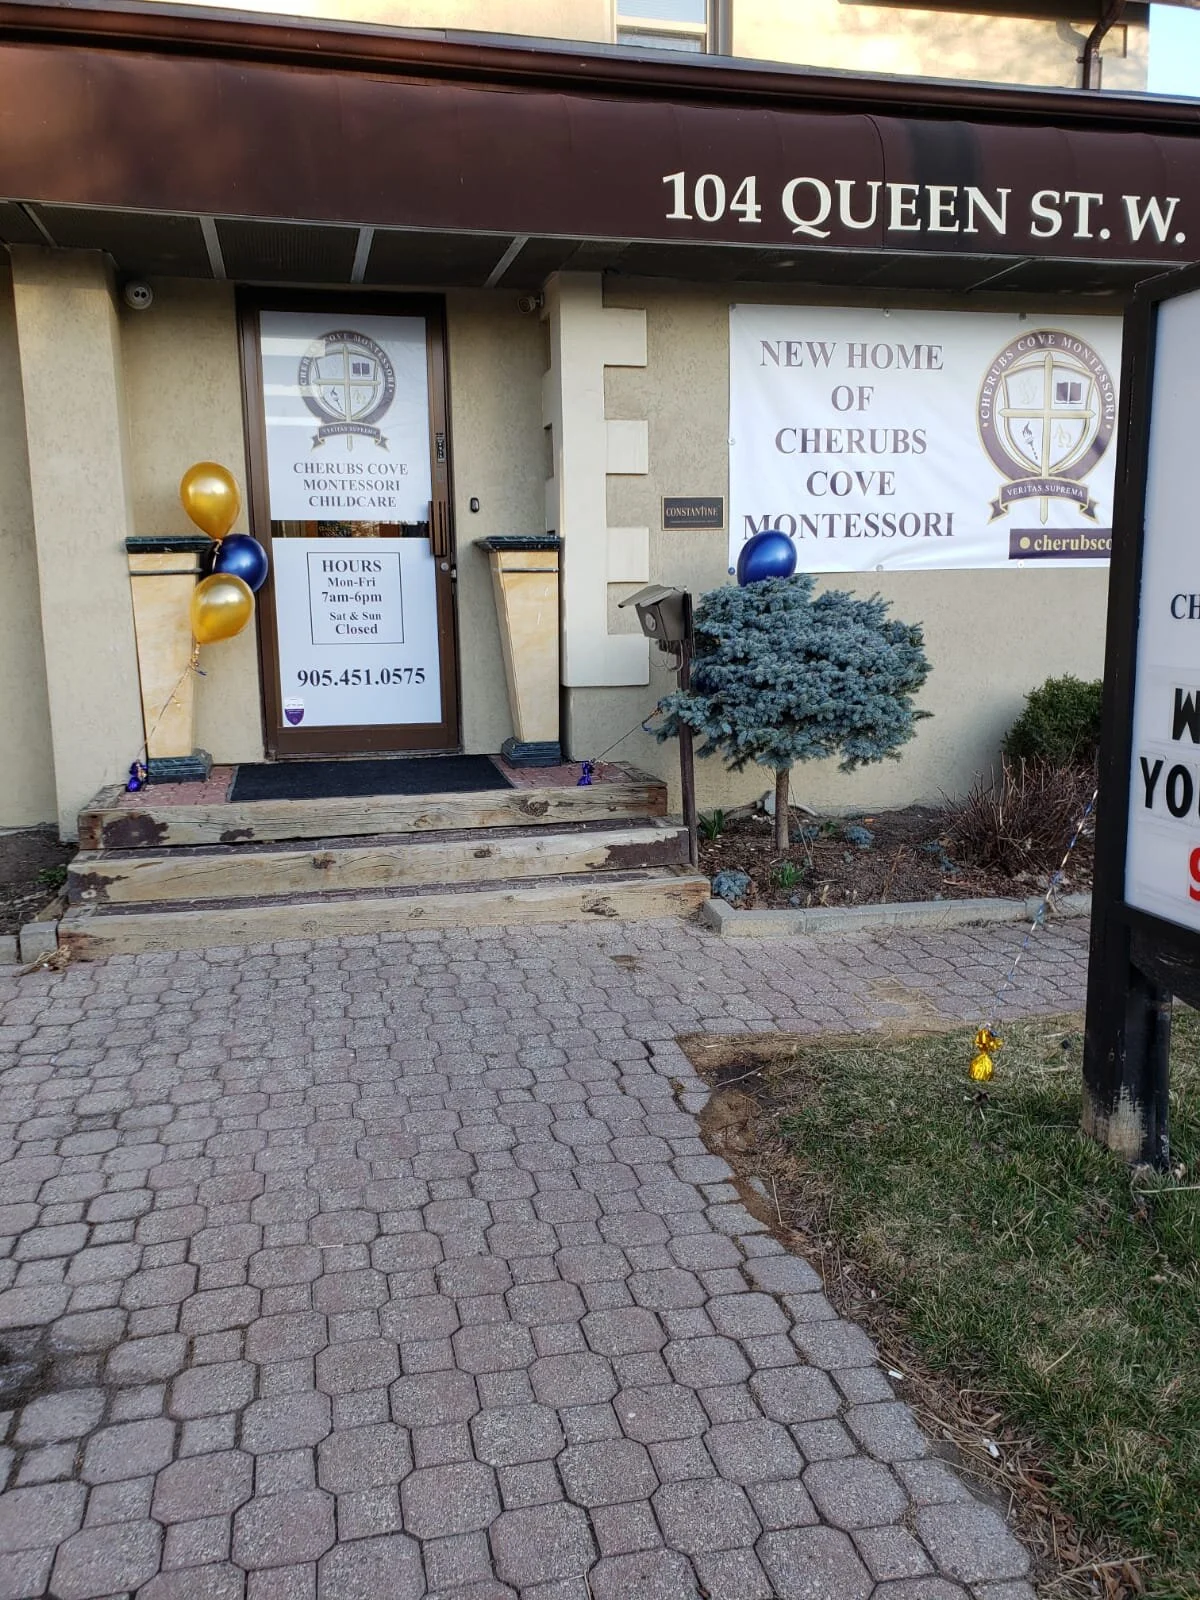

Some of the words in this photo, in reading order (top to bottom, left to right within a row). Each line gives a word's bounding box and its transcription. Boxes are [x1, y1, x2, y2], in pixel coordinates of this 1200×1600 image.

[662, 171, 762, 223] 104
[781, 176, 1012, 239] QUEEN
[1030, 189, 1111, 239] ST.
[1121, 194, 1186, 244] W.
[759, 340, 837, 368] NEW
[846, 342, 944, 370] HOME
[980, 351, 1014, 420] CHERUBS
[1017, 334, 1056, 351] COVE
[1061, 336, 1115, 420] MONTESSORI
[831, 385, 874, 411] OF
[774, 427, 927, 454] CHERUBS
[293, 462, 364, 475] CHERUBS
[367, 463, 408, 475] COVE
[303, 479, 400, 491] MONTESSORI
[806, 470, 896, 496] COVE
[1006, 484, 1042, 497] VERITAS
[1045, 484, 1084, 498] SUPREMA
[309, 495, 397, 507] CHILDCARE
[742, 512, 956, 540] MONTESSORI
[322, 559, 382, 573] HOURS
[327, 577, 376, 588] Mon-Fri
[321, 591, 382, 605] 7am-6pm
[329, 612, 346, 621] Sat
[349, 612, 359, 621] &
[362, 612, 382, 621] Sun
[335, 623, 378, 635] Closed
[297, 667, 426, 688] 905.451.0575
